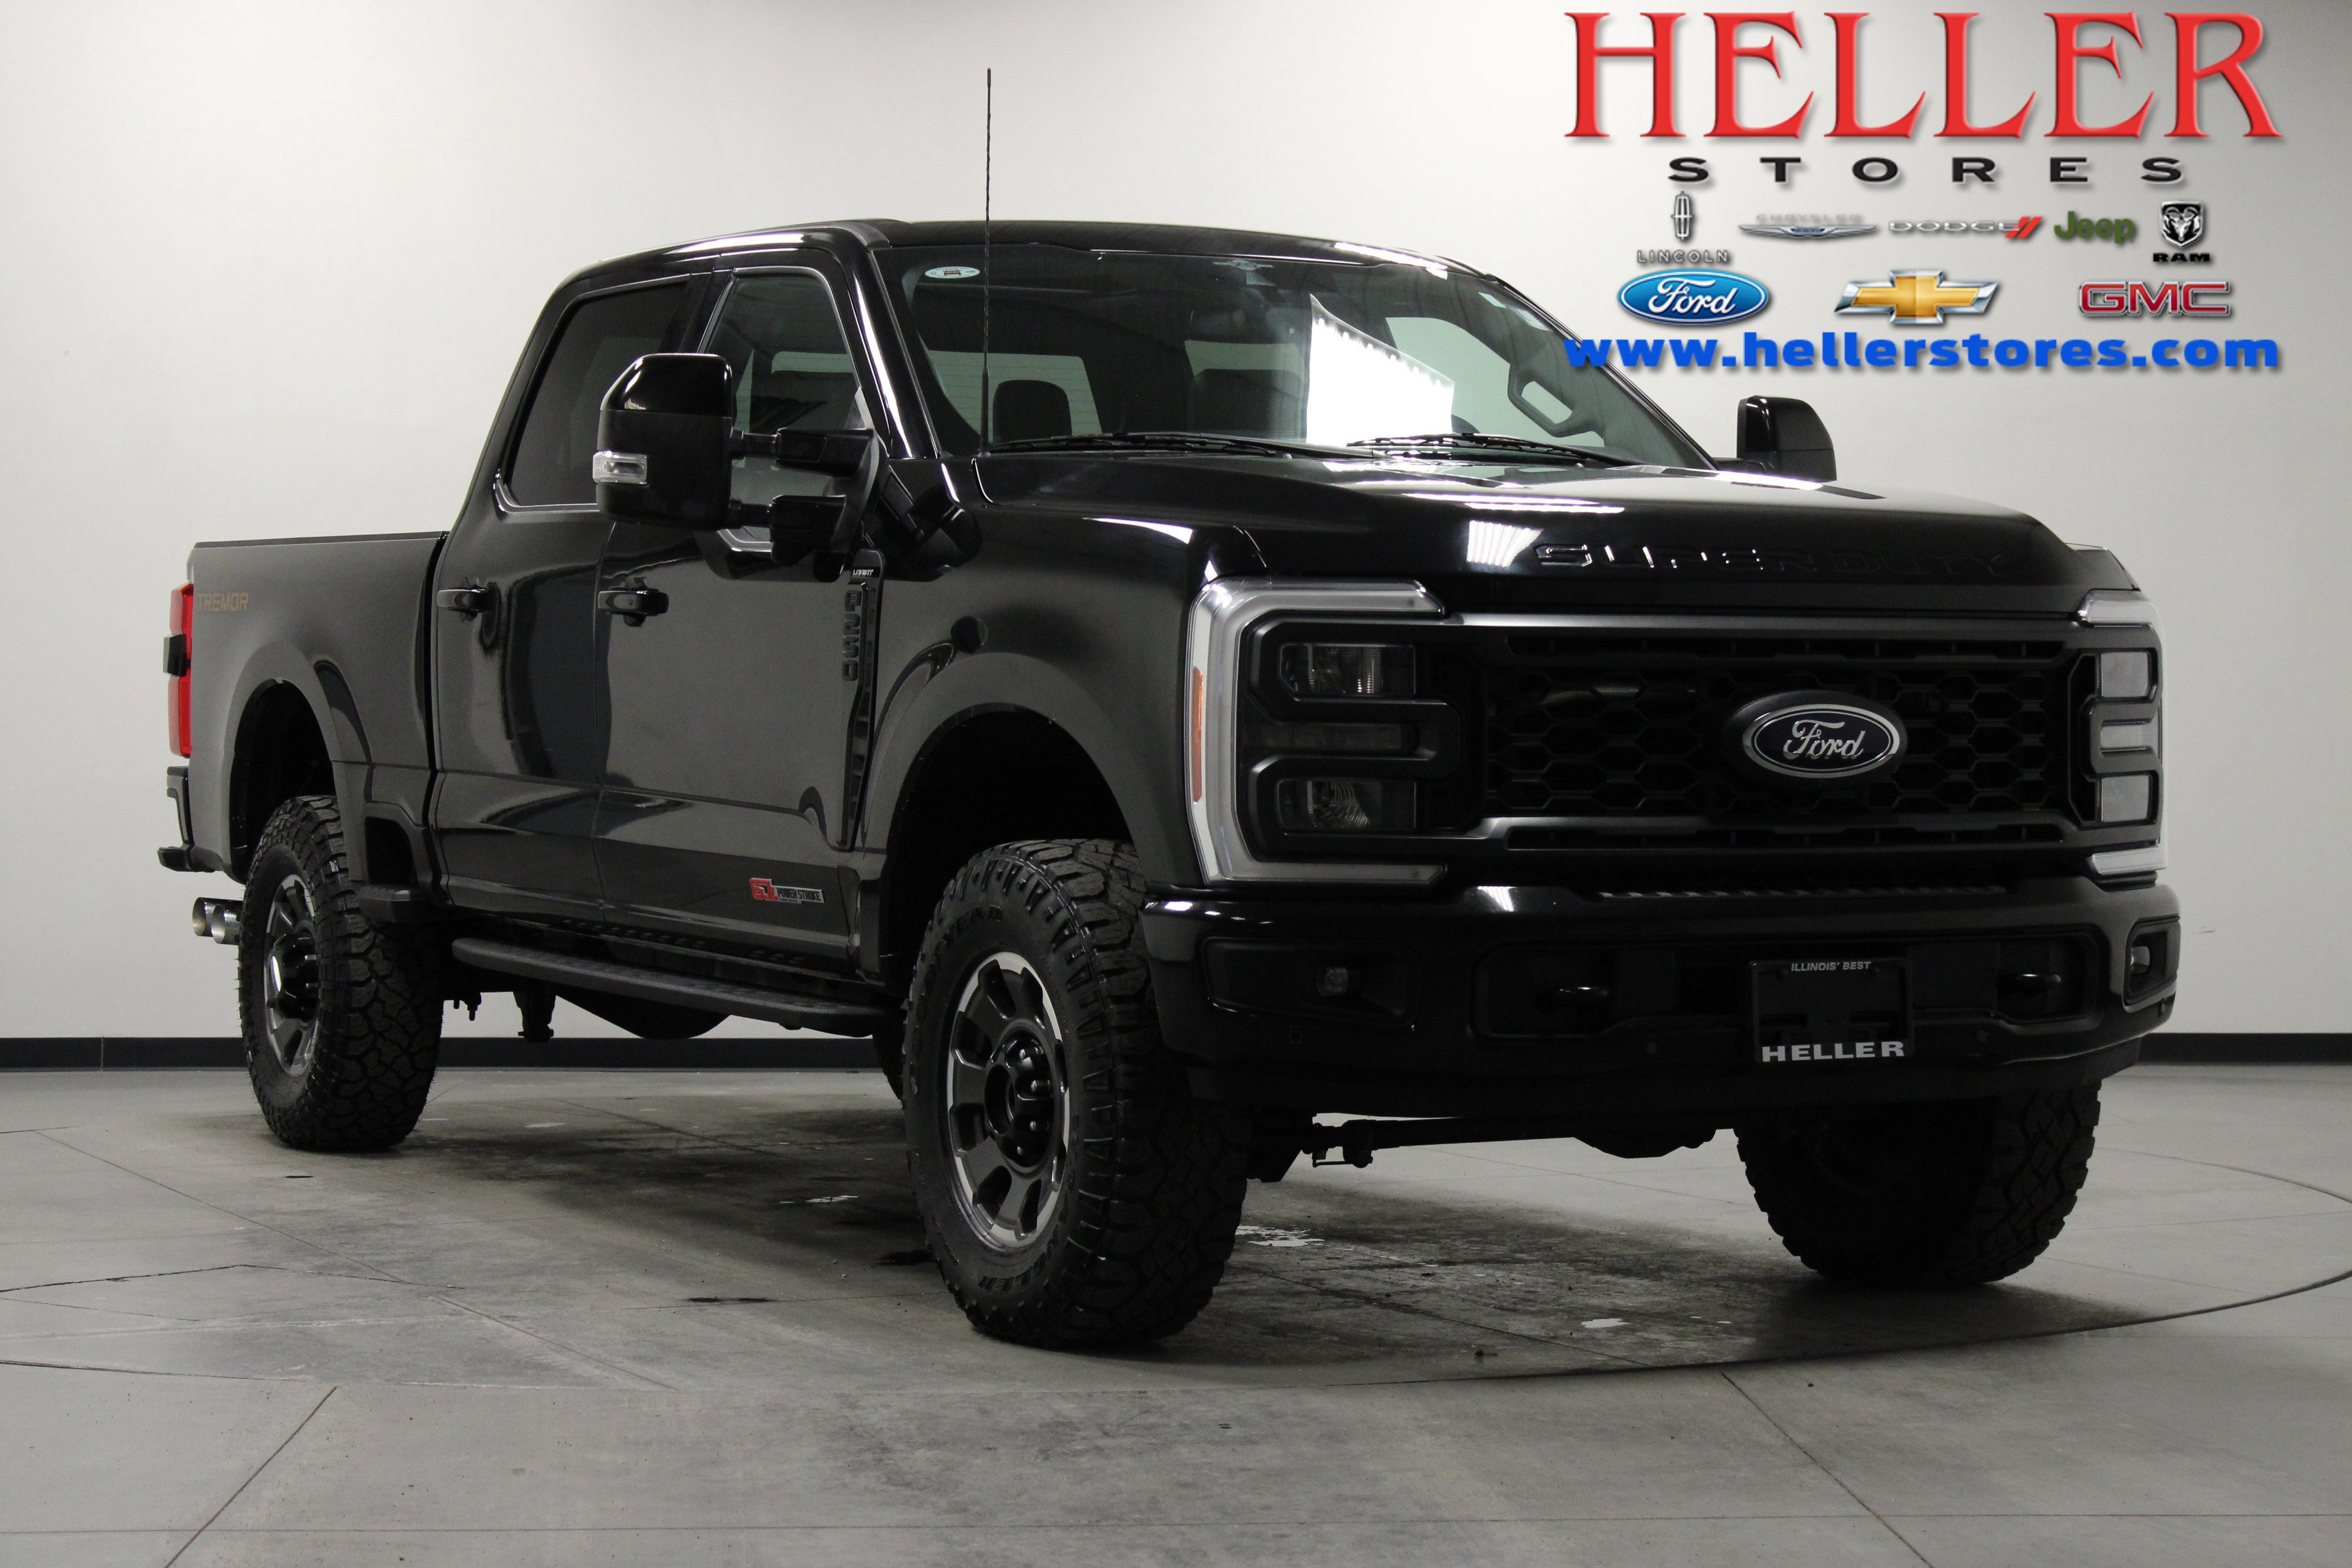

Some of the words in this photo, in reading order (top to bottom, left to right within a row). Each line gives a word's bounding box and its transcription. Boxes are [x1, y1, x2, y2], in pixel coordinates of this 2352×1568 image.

[197, 592, 250, 612] TREMOR
[1783, 719, 1866, 758] Ford
[776, 887, 797, 899] POWER
[798, 889, 821, 901] STROKE
[1842, 961, 1871, 970] BEST
[1762, 1041, 1905, 1062] HELLER
